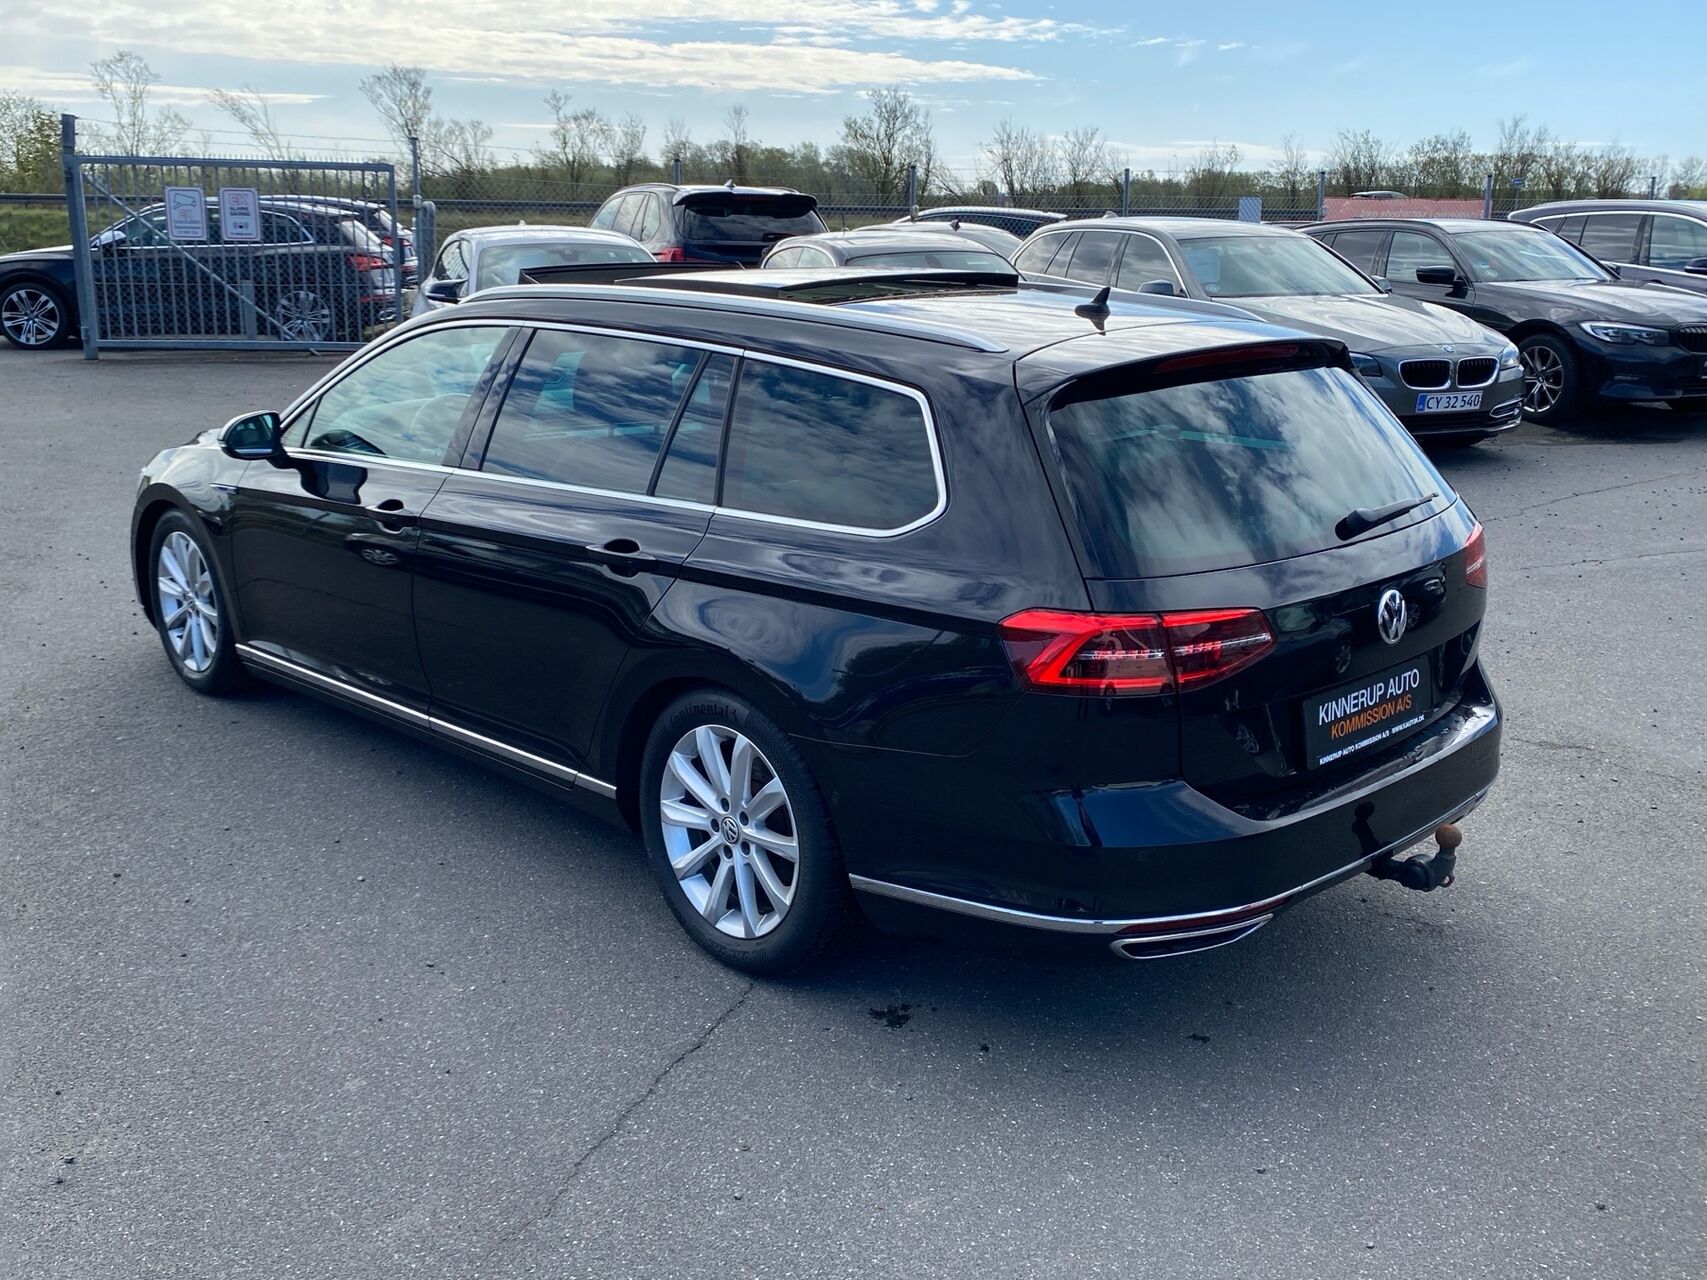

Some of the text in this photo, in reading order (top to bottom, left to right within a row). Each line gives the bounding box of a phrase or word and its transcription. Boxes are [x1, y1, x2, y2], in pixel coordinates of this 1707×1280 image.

[1426, 394, 1480, 409] CY 32 540
[671, 702, 729, 723] Continental
[1318, 668, 1420, 727] KINNERUP AUTO
[1330, 694, 1412, 740] KOMMISSION A/S
[1319, 751, 1342, 765] KINNERUP
[1342, 744, 1355, 756] AUTO
[1355, 734, 1382, 749] KOMMISSION
